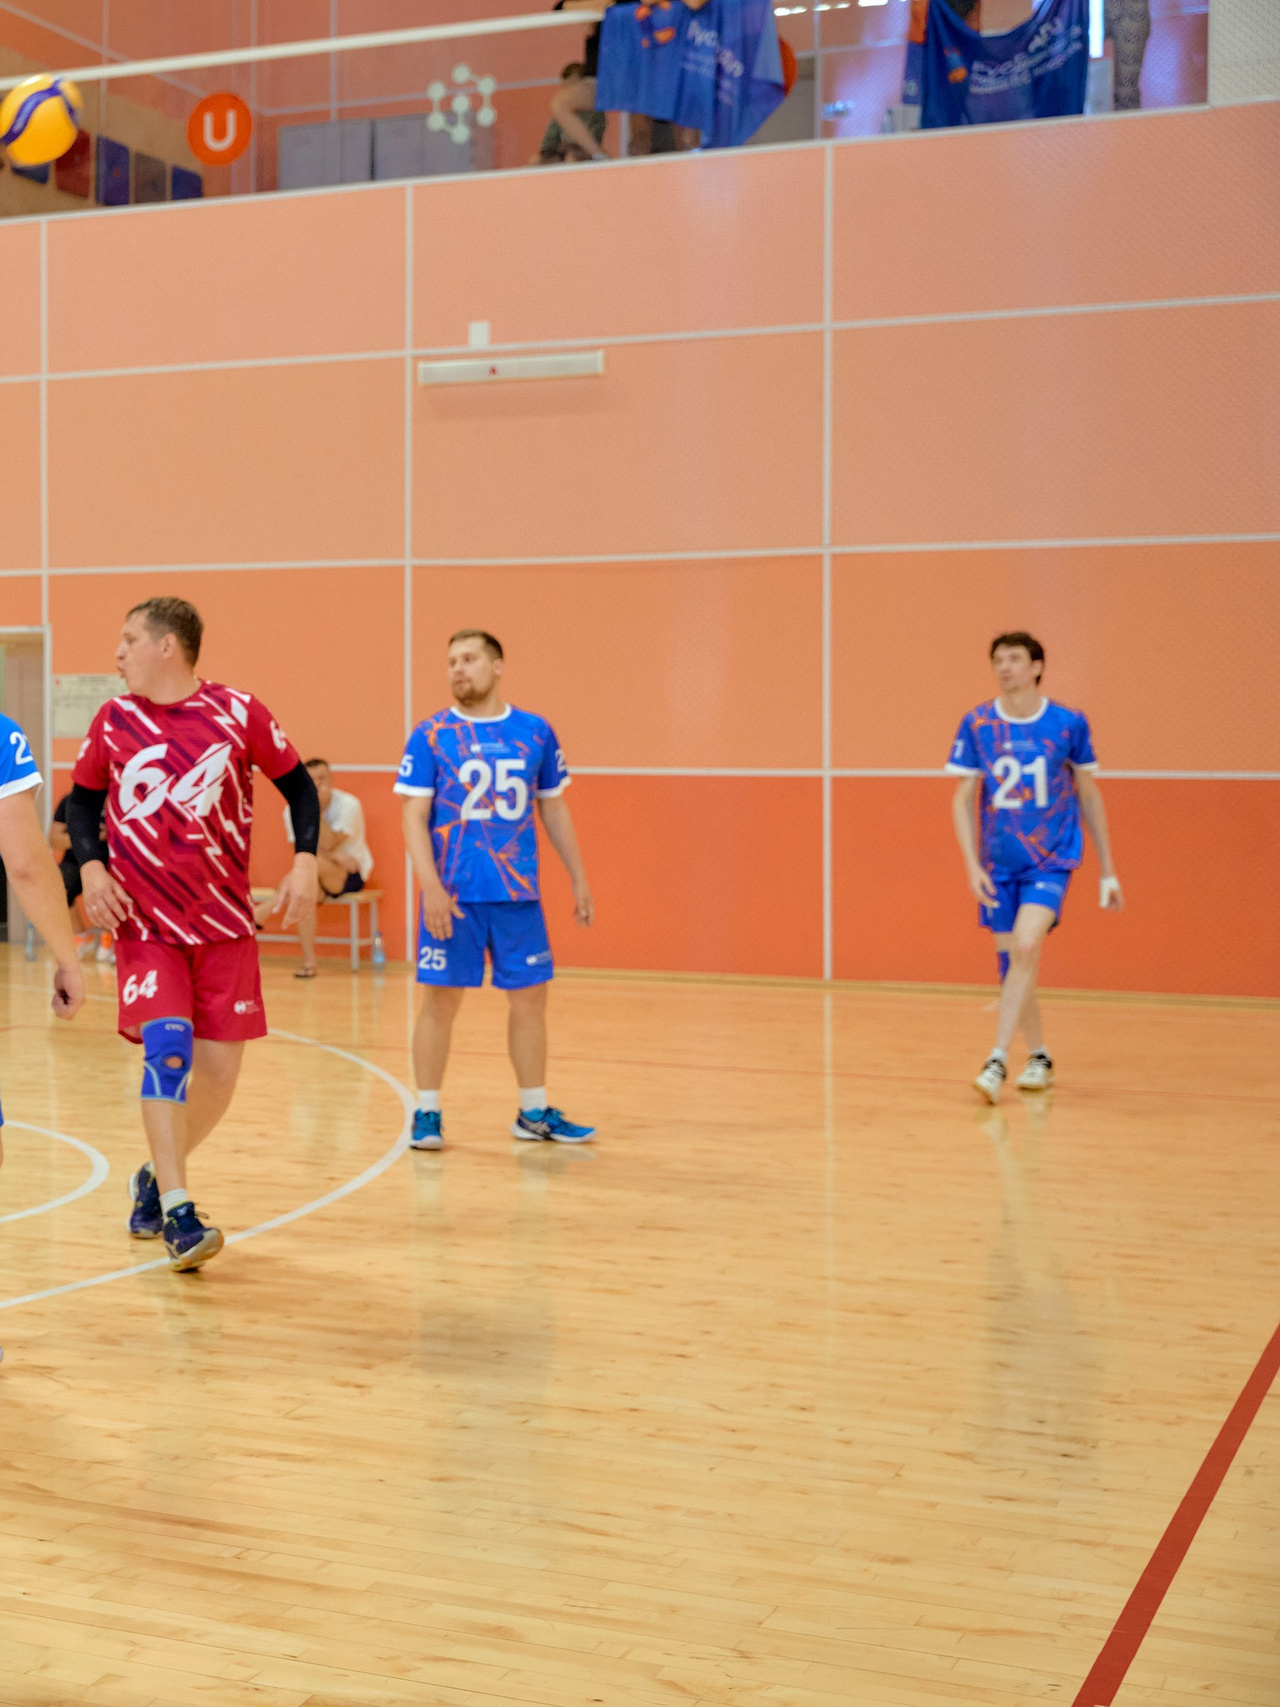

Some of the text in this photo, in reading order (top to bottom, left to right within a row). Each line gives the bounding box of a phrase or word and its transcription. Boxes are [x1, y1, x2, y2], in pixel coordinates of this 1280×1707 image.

[202, 108, 237, 152] U
[9, 731, 34, 765] 2
[118, 740, 232, 822] 64
[459, 759, 528, 821] 25
[992, 755, 1048, 808] 21
[418, 946, 447, 971] 25
[123, 970, 158, 1006] 64
